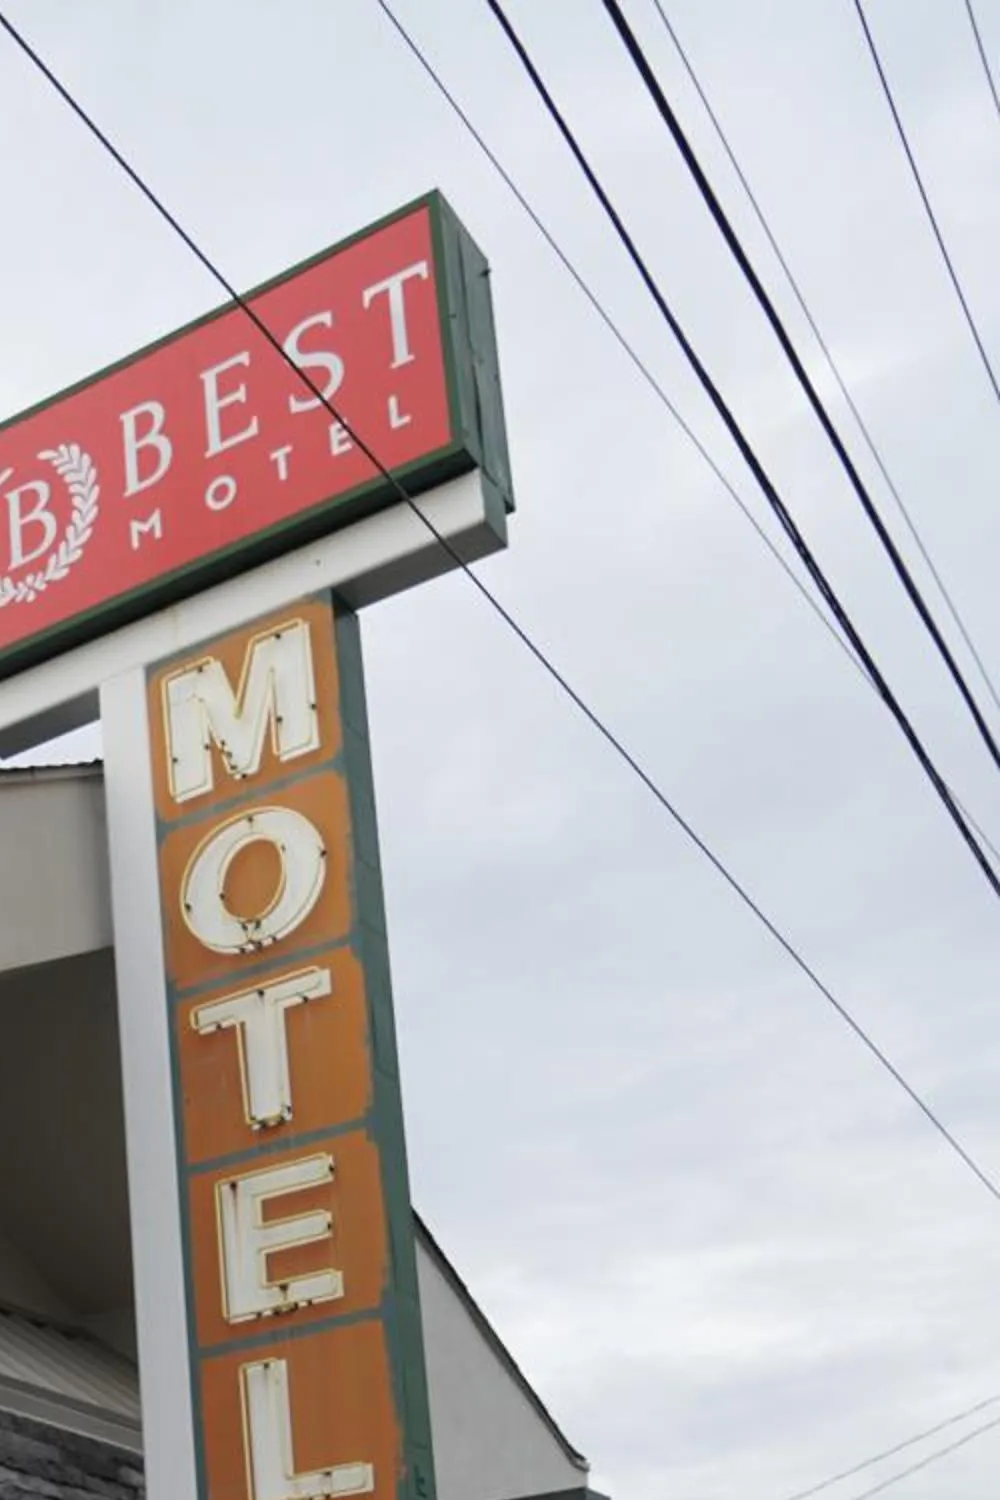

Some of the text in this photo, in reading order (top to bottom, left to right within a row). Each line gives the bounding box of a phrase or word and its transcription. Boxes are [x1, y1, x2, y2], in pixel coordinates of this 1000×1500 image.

[119, 261, 428, 498] BEST
[3, 479, 58, 571] B
[129, 395, 410, 550] MOTEL
